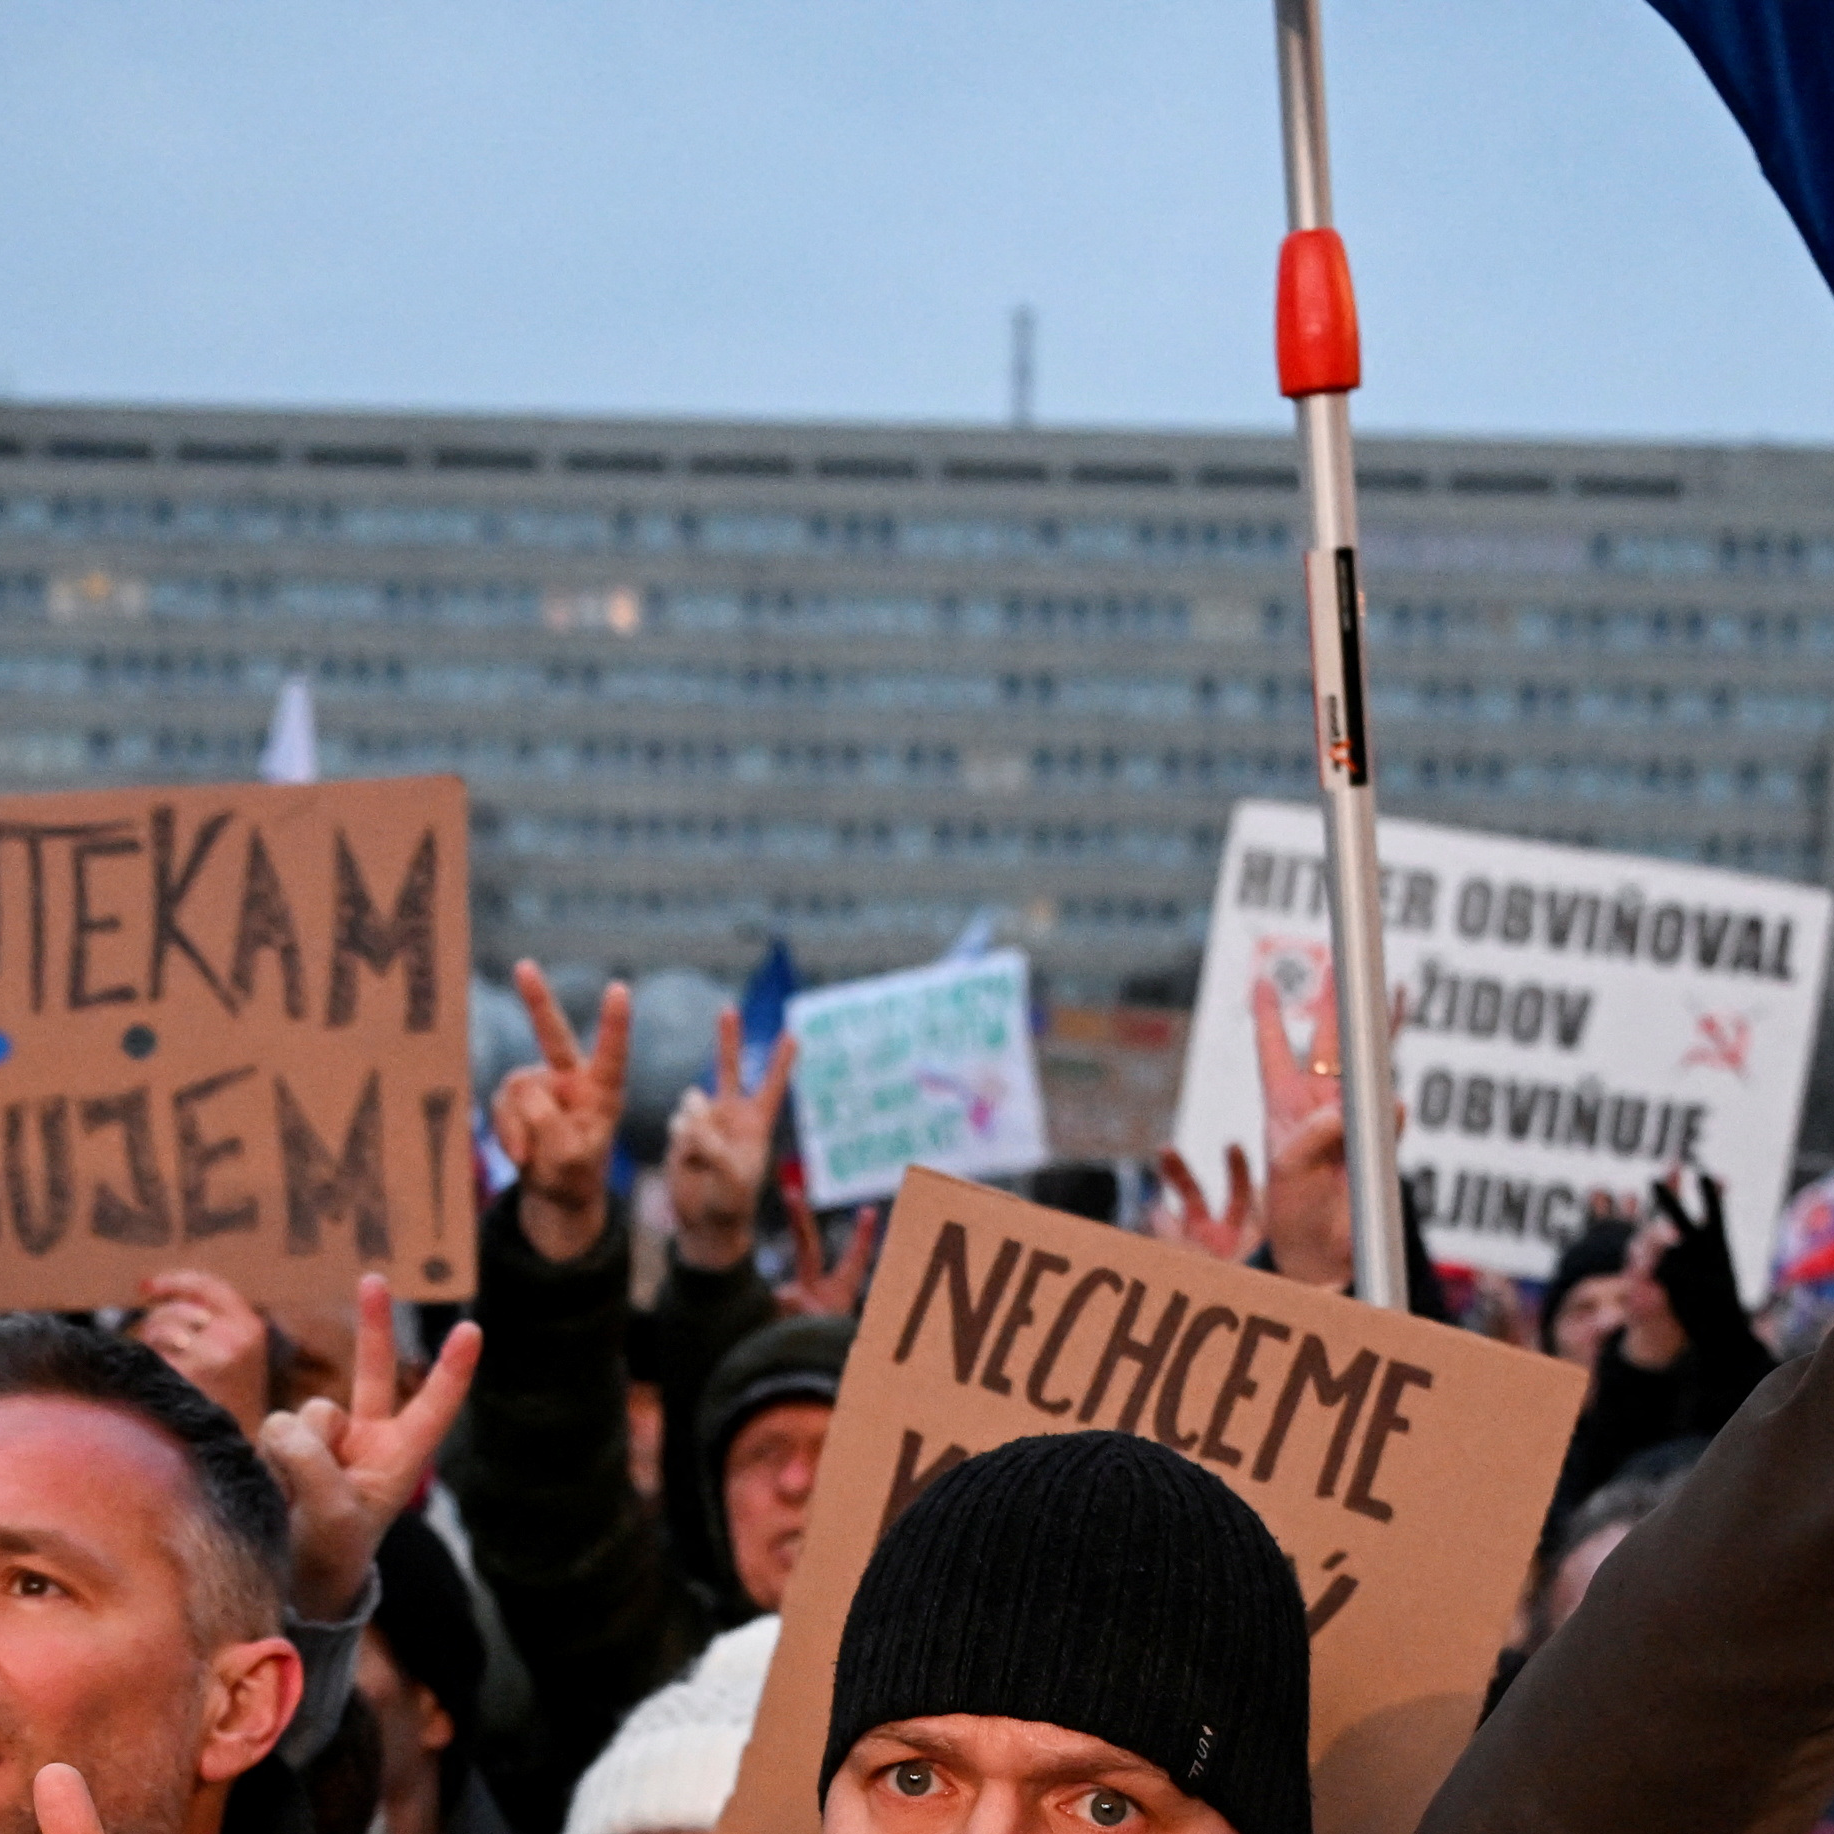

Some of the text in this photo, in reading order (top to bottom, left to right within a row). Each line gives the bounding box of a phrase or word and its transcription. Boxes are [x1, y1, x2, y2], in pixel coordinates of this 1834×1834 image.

[1236, 851, 1797, 981] HITER OBVIŇOVAL
[1413, 958, 1594, 1052] ŽIDOV
[1420, 1068, 1708, 1161] OBVIŇUJE
[893, 1221, 1434, 1524] NECHCEME
